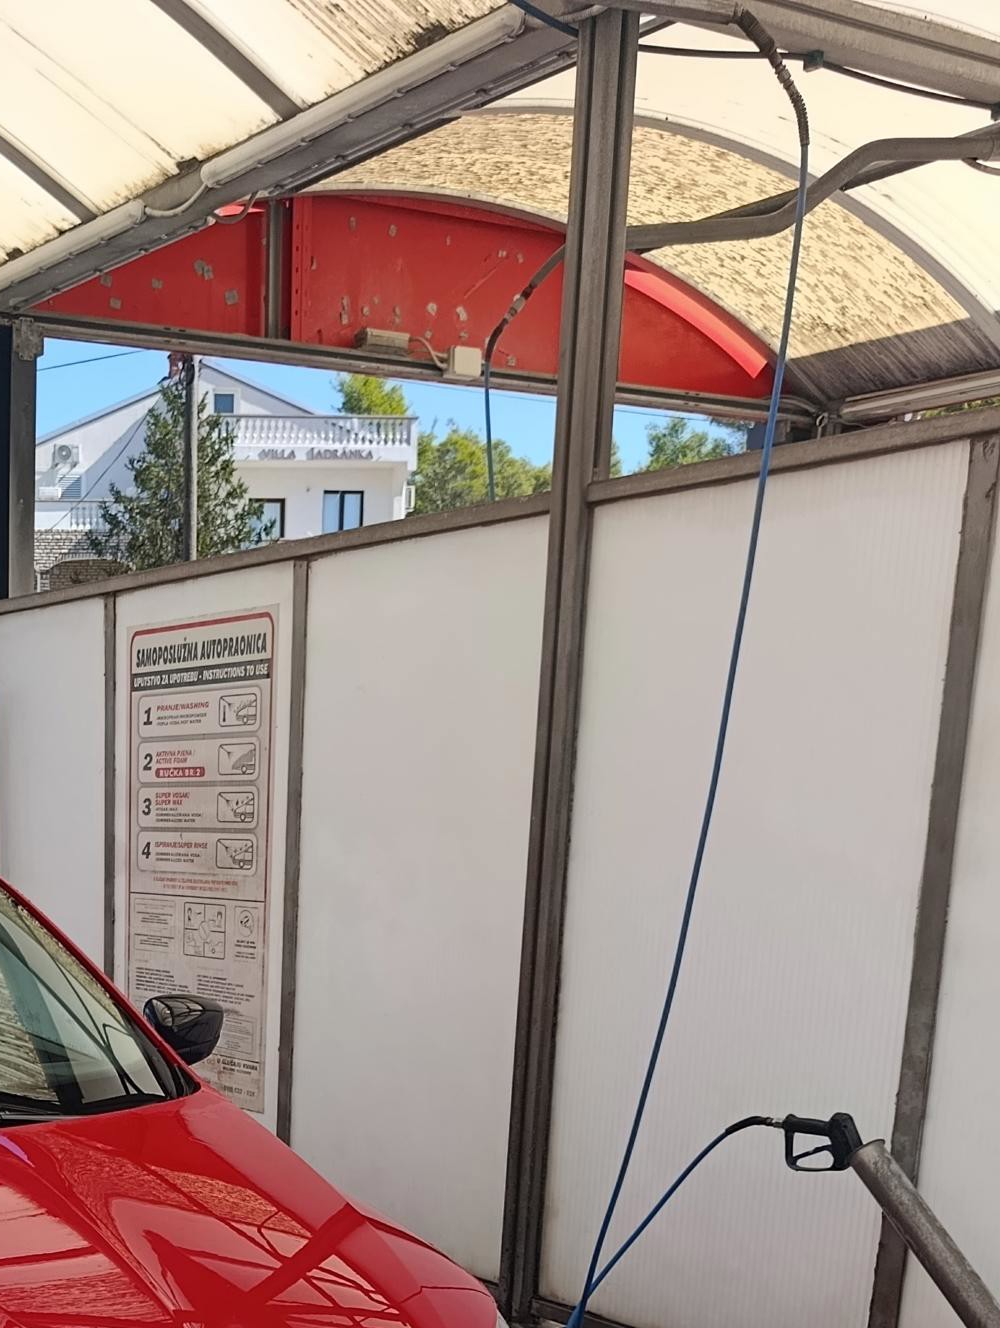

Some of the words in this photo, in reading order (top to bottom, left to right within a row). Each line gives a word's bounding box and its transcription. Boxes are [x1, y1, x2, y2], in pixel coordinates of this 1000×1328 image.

[136, 637, 198, 668] SAMOPOSLUŽNA
[200, 632, 267, 660] AUTOPRAONICA
[161, 674, 169, 684] ZA
[170, 671, 199, 683] UPOTREBU
[203, 667, 245, 680] INSTRUCTIONS
[246, 665, 255, 676] TO
[256, 663, 268, 675] USE
[143, 707, 153, 726] 1
[143, 752, 153, 771] 2
[142, 797, 152, 816] 3
[141, 841, 151, 859] 4
